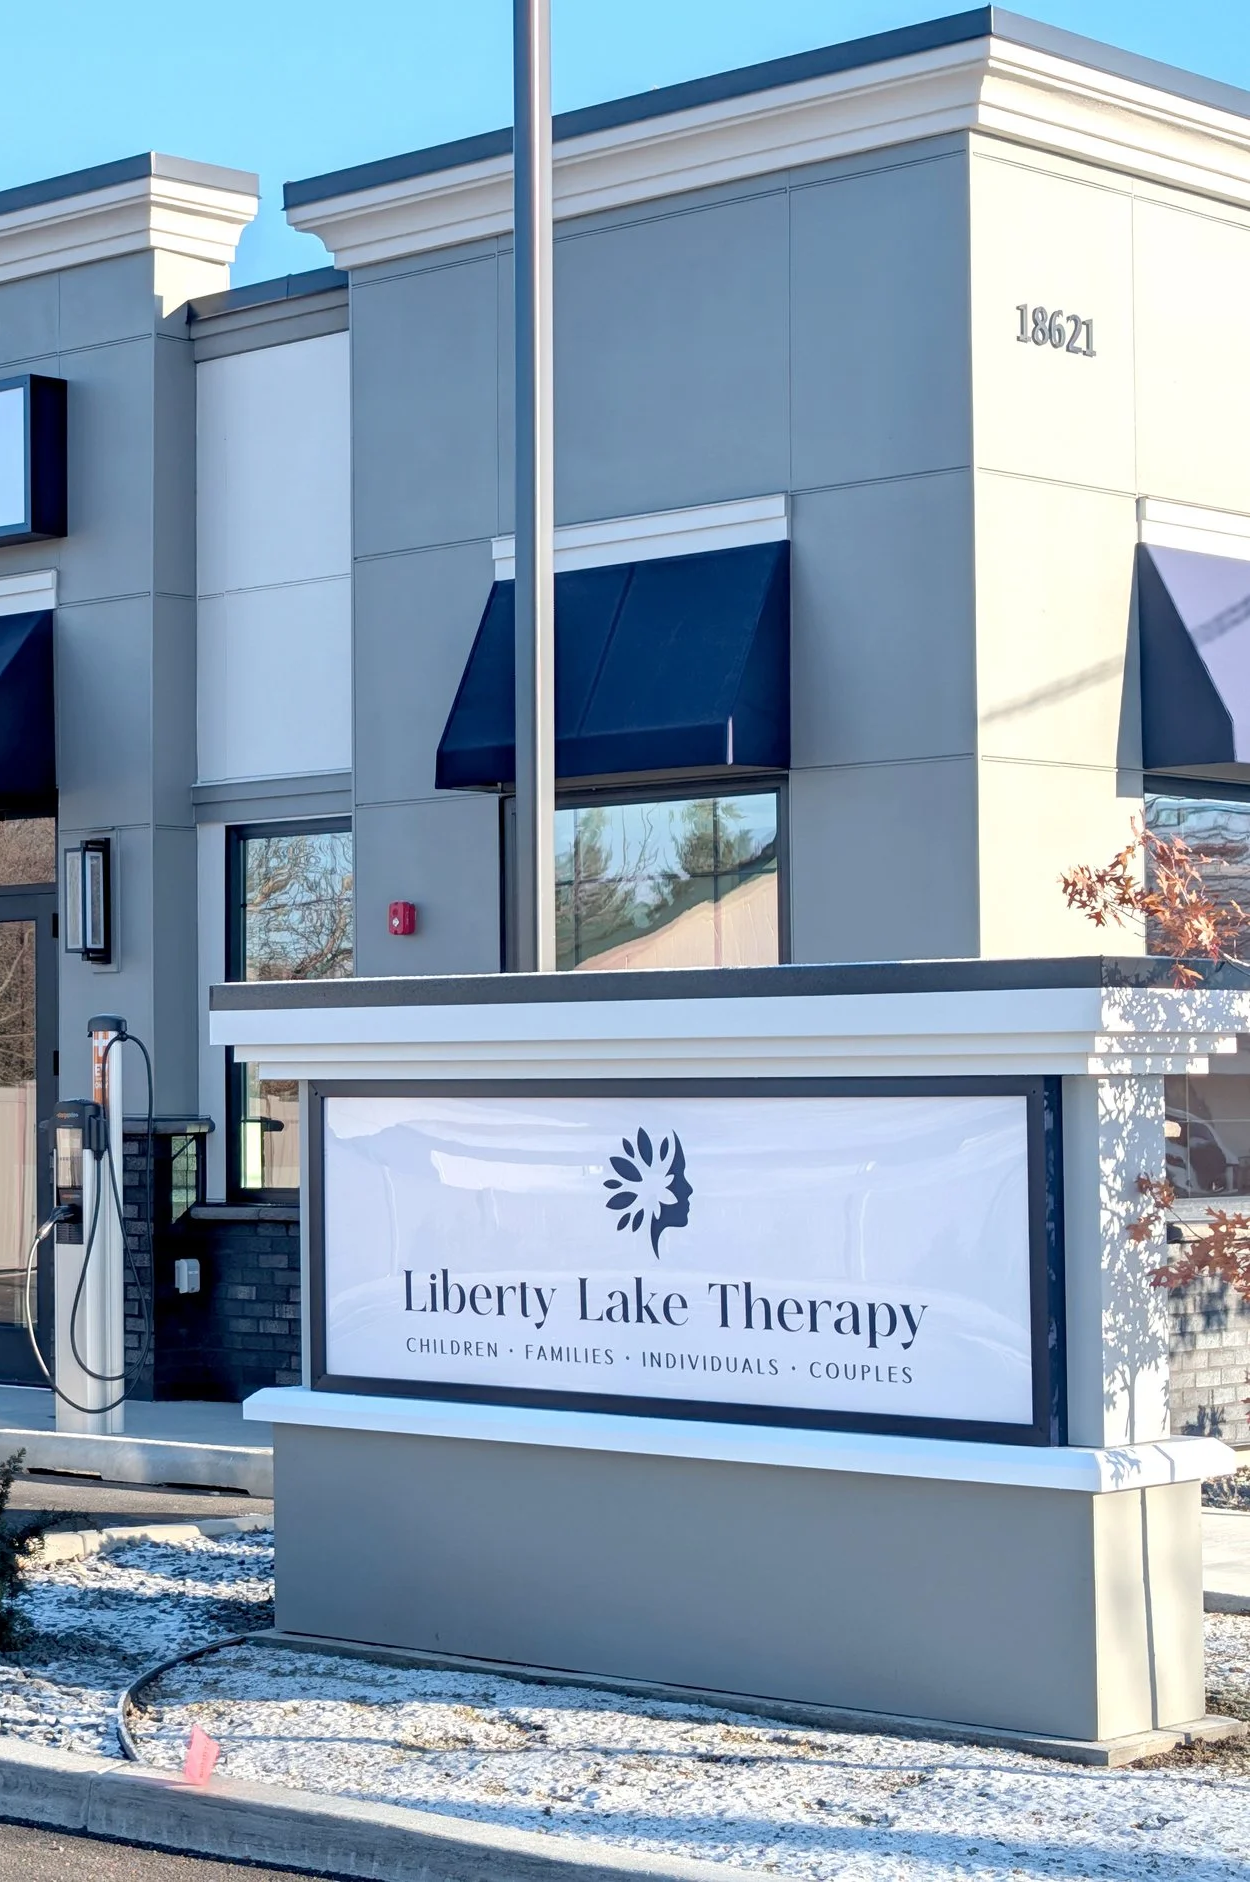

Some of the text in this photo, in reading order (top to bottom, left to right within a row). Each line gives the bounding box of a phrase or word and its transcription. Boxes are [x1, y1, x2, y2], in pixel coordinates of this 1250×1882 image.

[1014, 303, 1097, 358] 18621
[403, 1268, 929, 1350] Liberty Lake Therapy
[406, 1337, 913, 1384] CHILDREN FAMILIES INDIVIDUALS COUPLES
